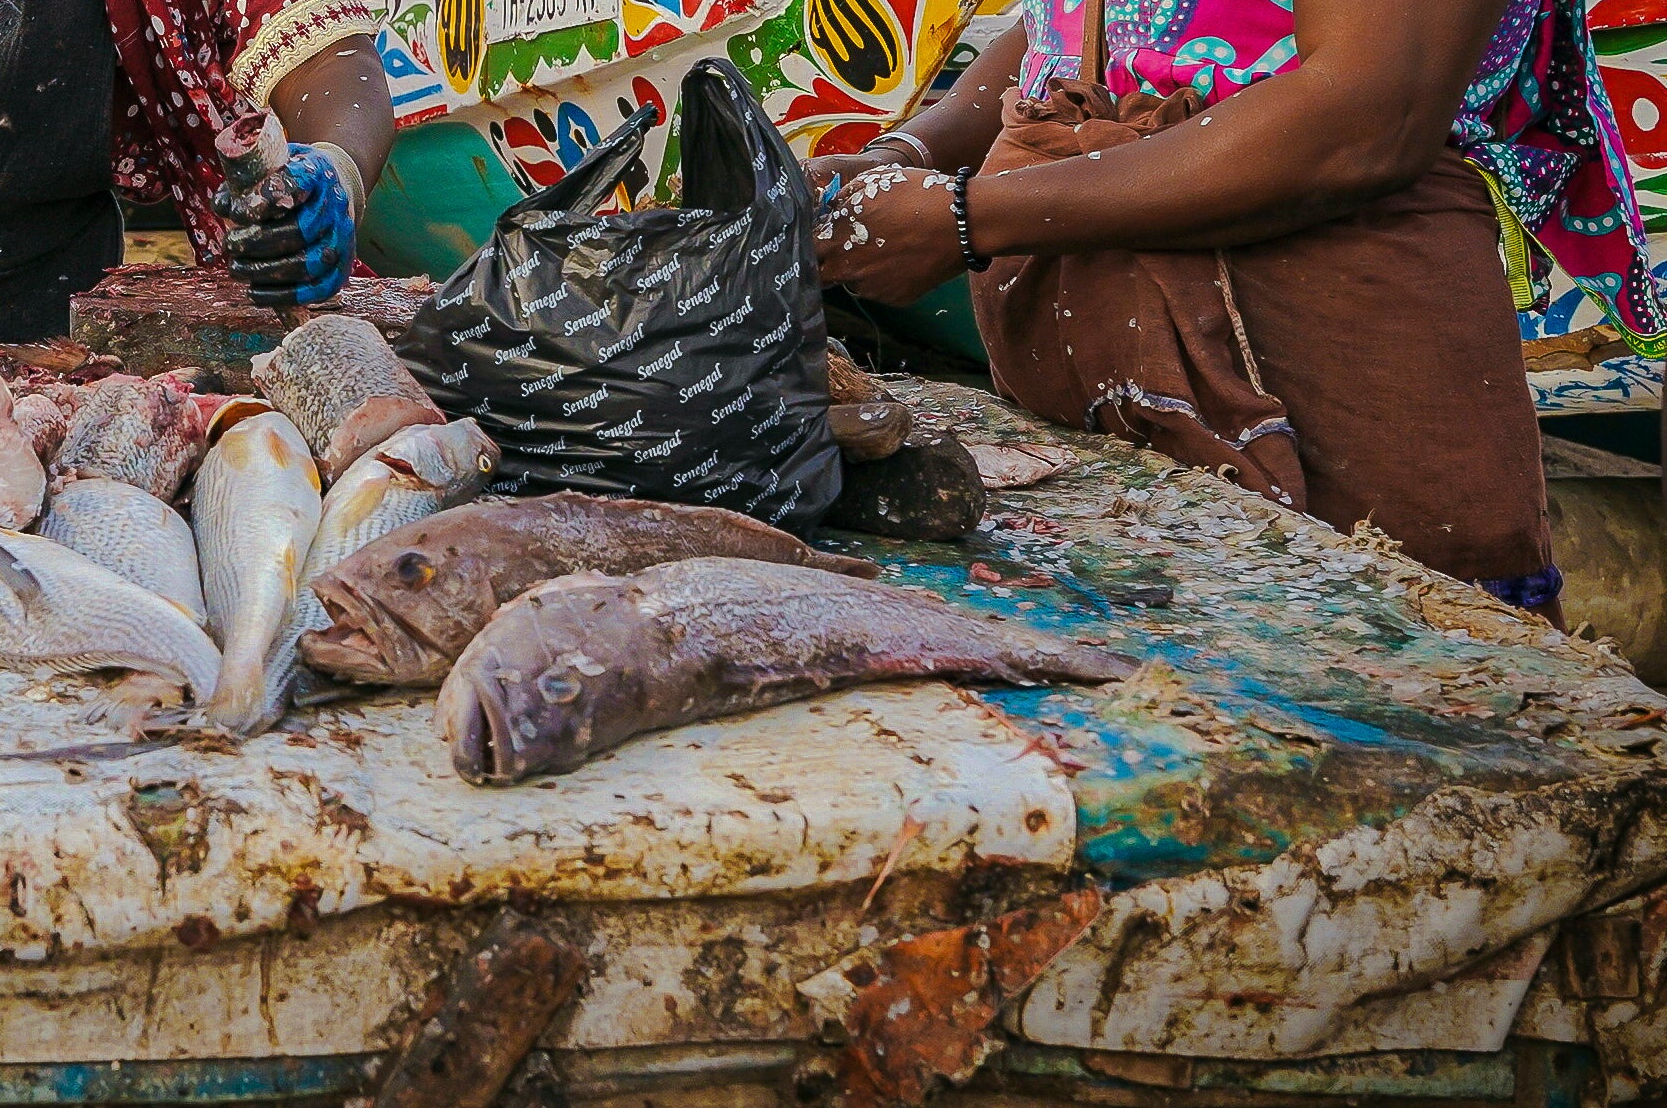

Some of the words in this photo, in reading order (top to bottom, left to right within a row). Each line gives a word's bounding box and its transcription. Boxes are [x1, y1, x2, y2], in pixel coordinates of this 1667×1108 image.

[566, 215, 611, 250] Senegal
[709, 206, 753, 249] Senegal
[599, 235, 643, 277] Senegal
[636, 252, 681, 294] Senegal
[521, 281, 569, 318] Senegal
[677, 274, 721, 317] Senegal
[709, 295, 754, 337] Senegal
[451, 316, 492, 346] Senegal
[564, 299, 612, 337] Senegal
[752, 312, 792, 355] Senegal
[494, 335, 537, 365] Senegal
[598, 322, 645, 364] Senegal
[637, 340, 684, 381] Senegal
[520, 364, 565, 398] Senegal
[562, 382, 610, 417] Senegal
[678, 362, 724, 404] Senegal
[711, 382, 753, 425] Senegal
[750, 396, 787, 441] Senegal
[634, 428, 682, 464] Senegal
[673, 449, 720, 488] Senegal
